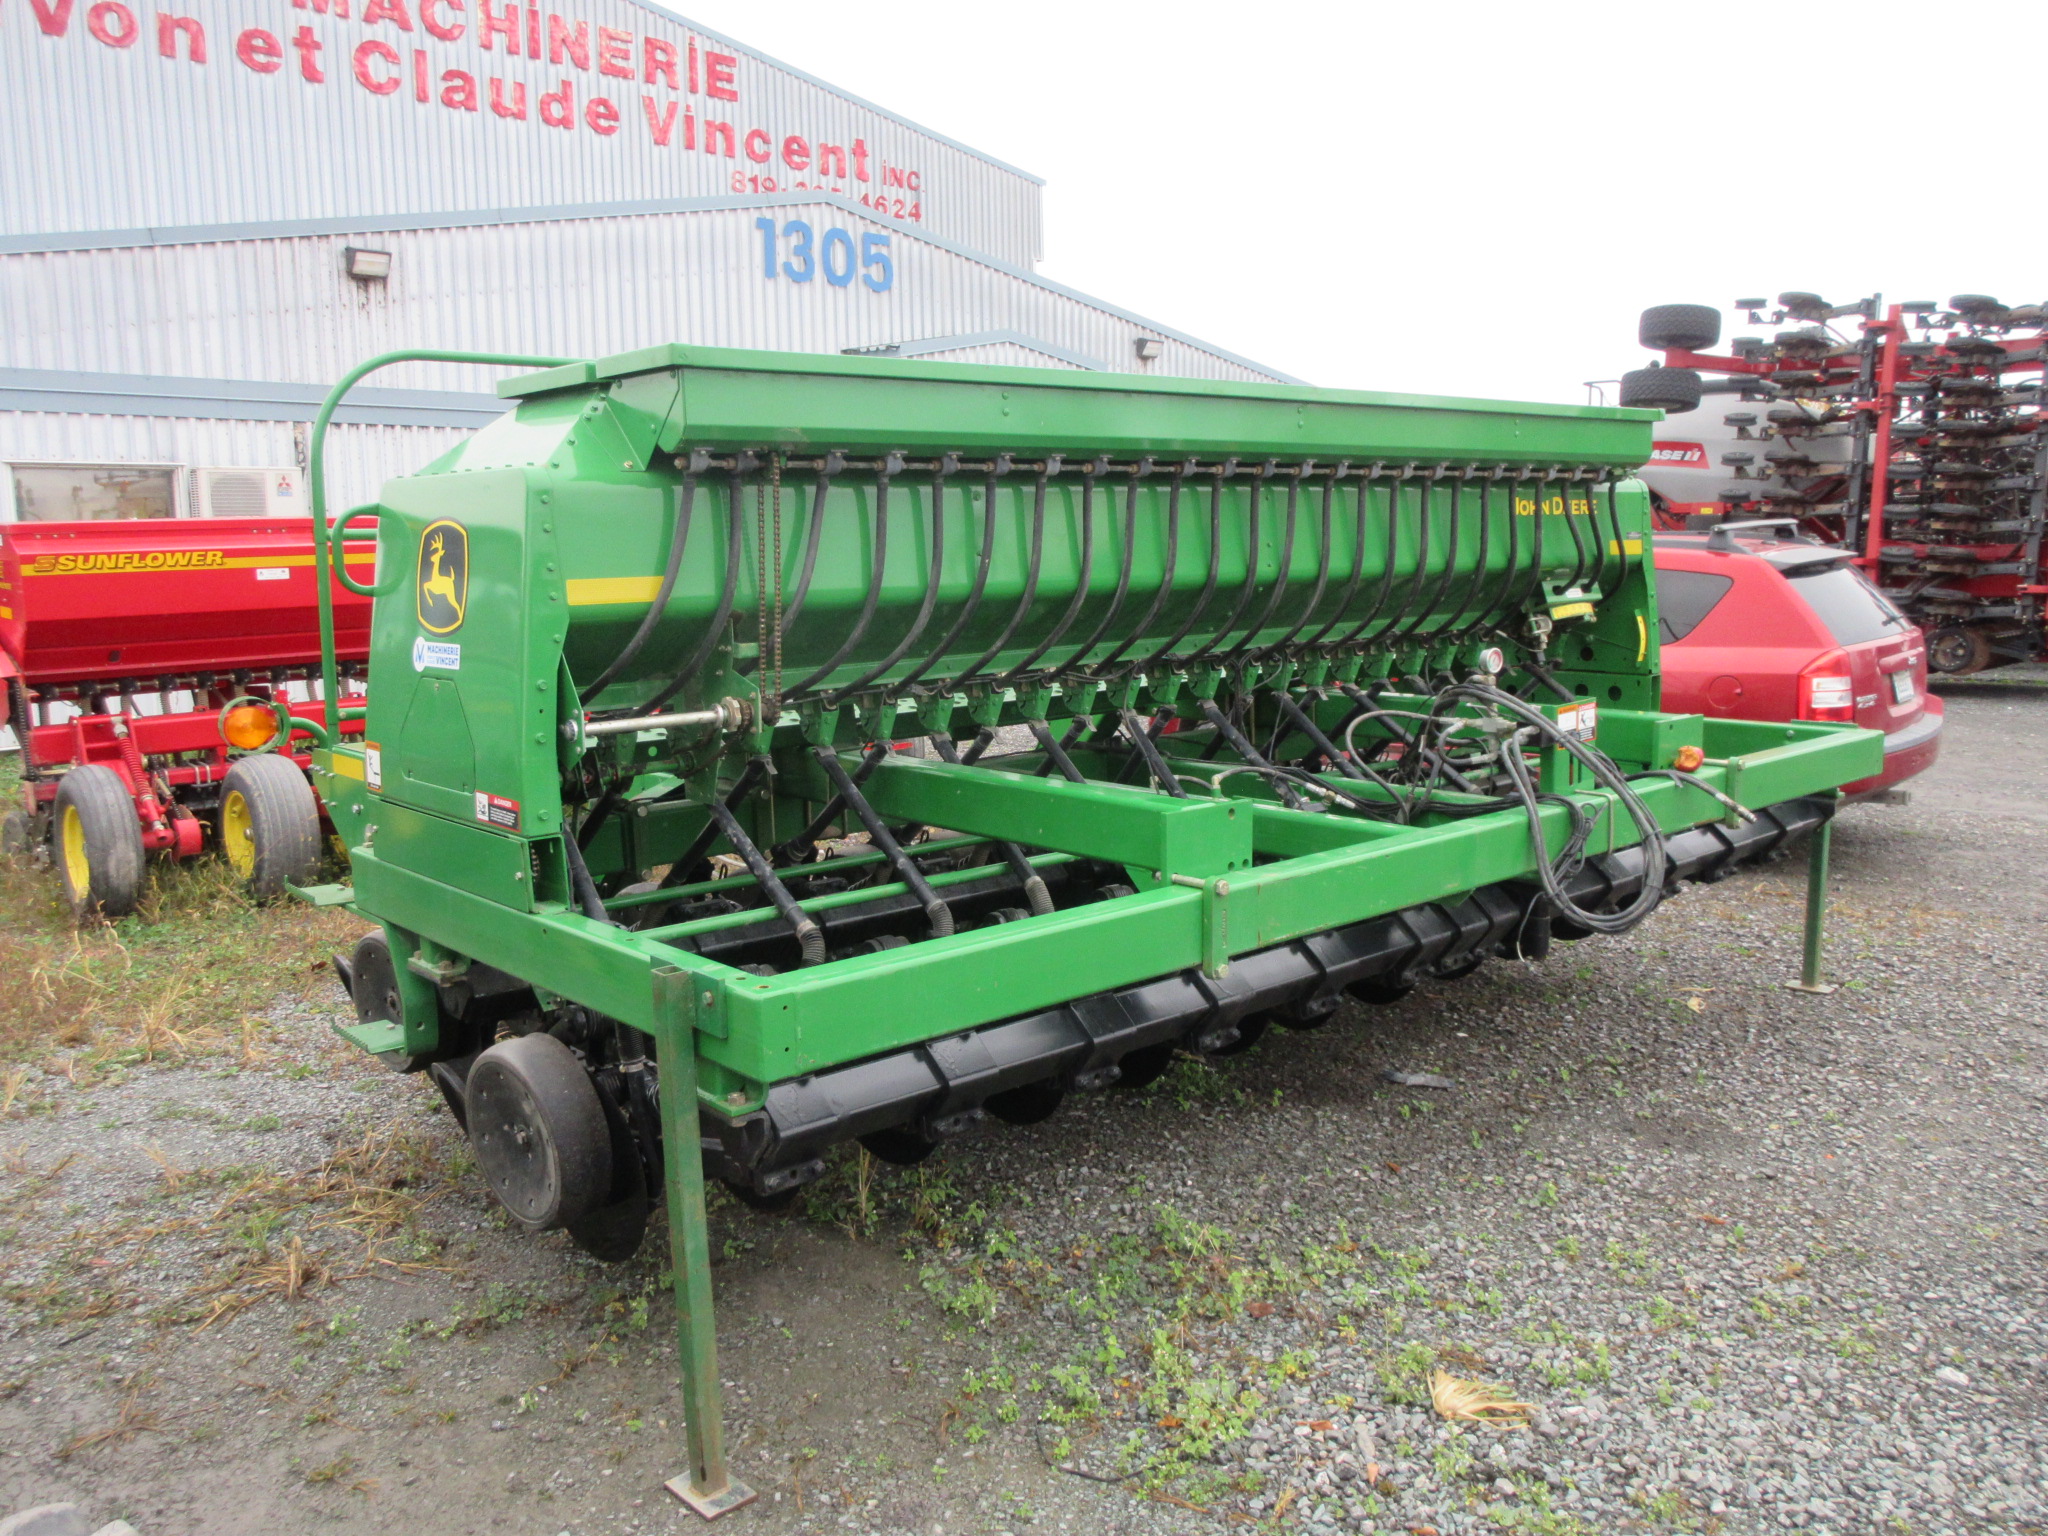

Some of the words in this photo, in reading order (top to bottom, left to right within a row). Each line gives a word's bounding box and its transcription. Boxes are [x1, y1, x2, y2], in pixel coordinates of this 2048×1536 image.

[236, 26, 325, 84] et
[353, 40, 621, 136] Claude
[642, 96, 870, 183] Vincent
[756, 216, 893, 291] 1305
[1650, 449, 1684, 461] ASE
[57, 550, 225, 571] SUNFLOWER
